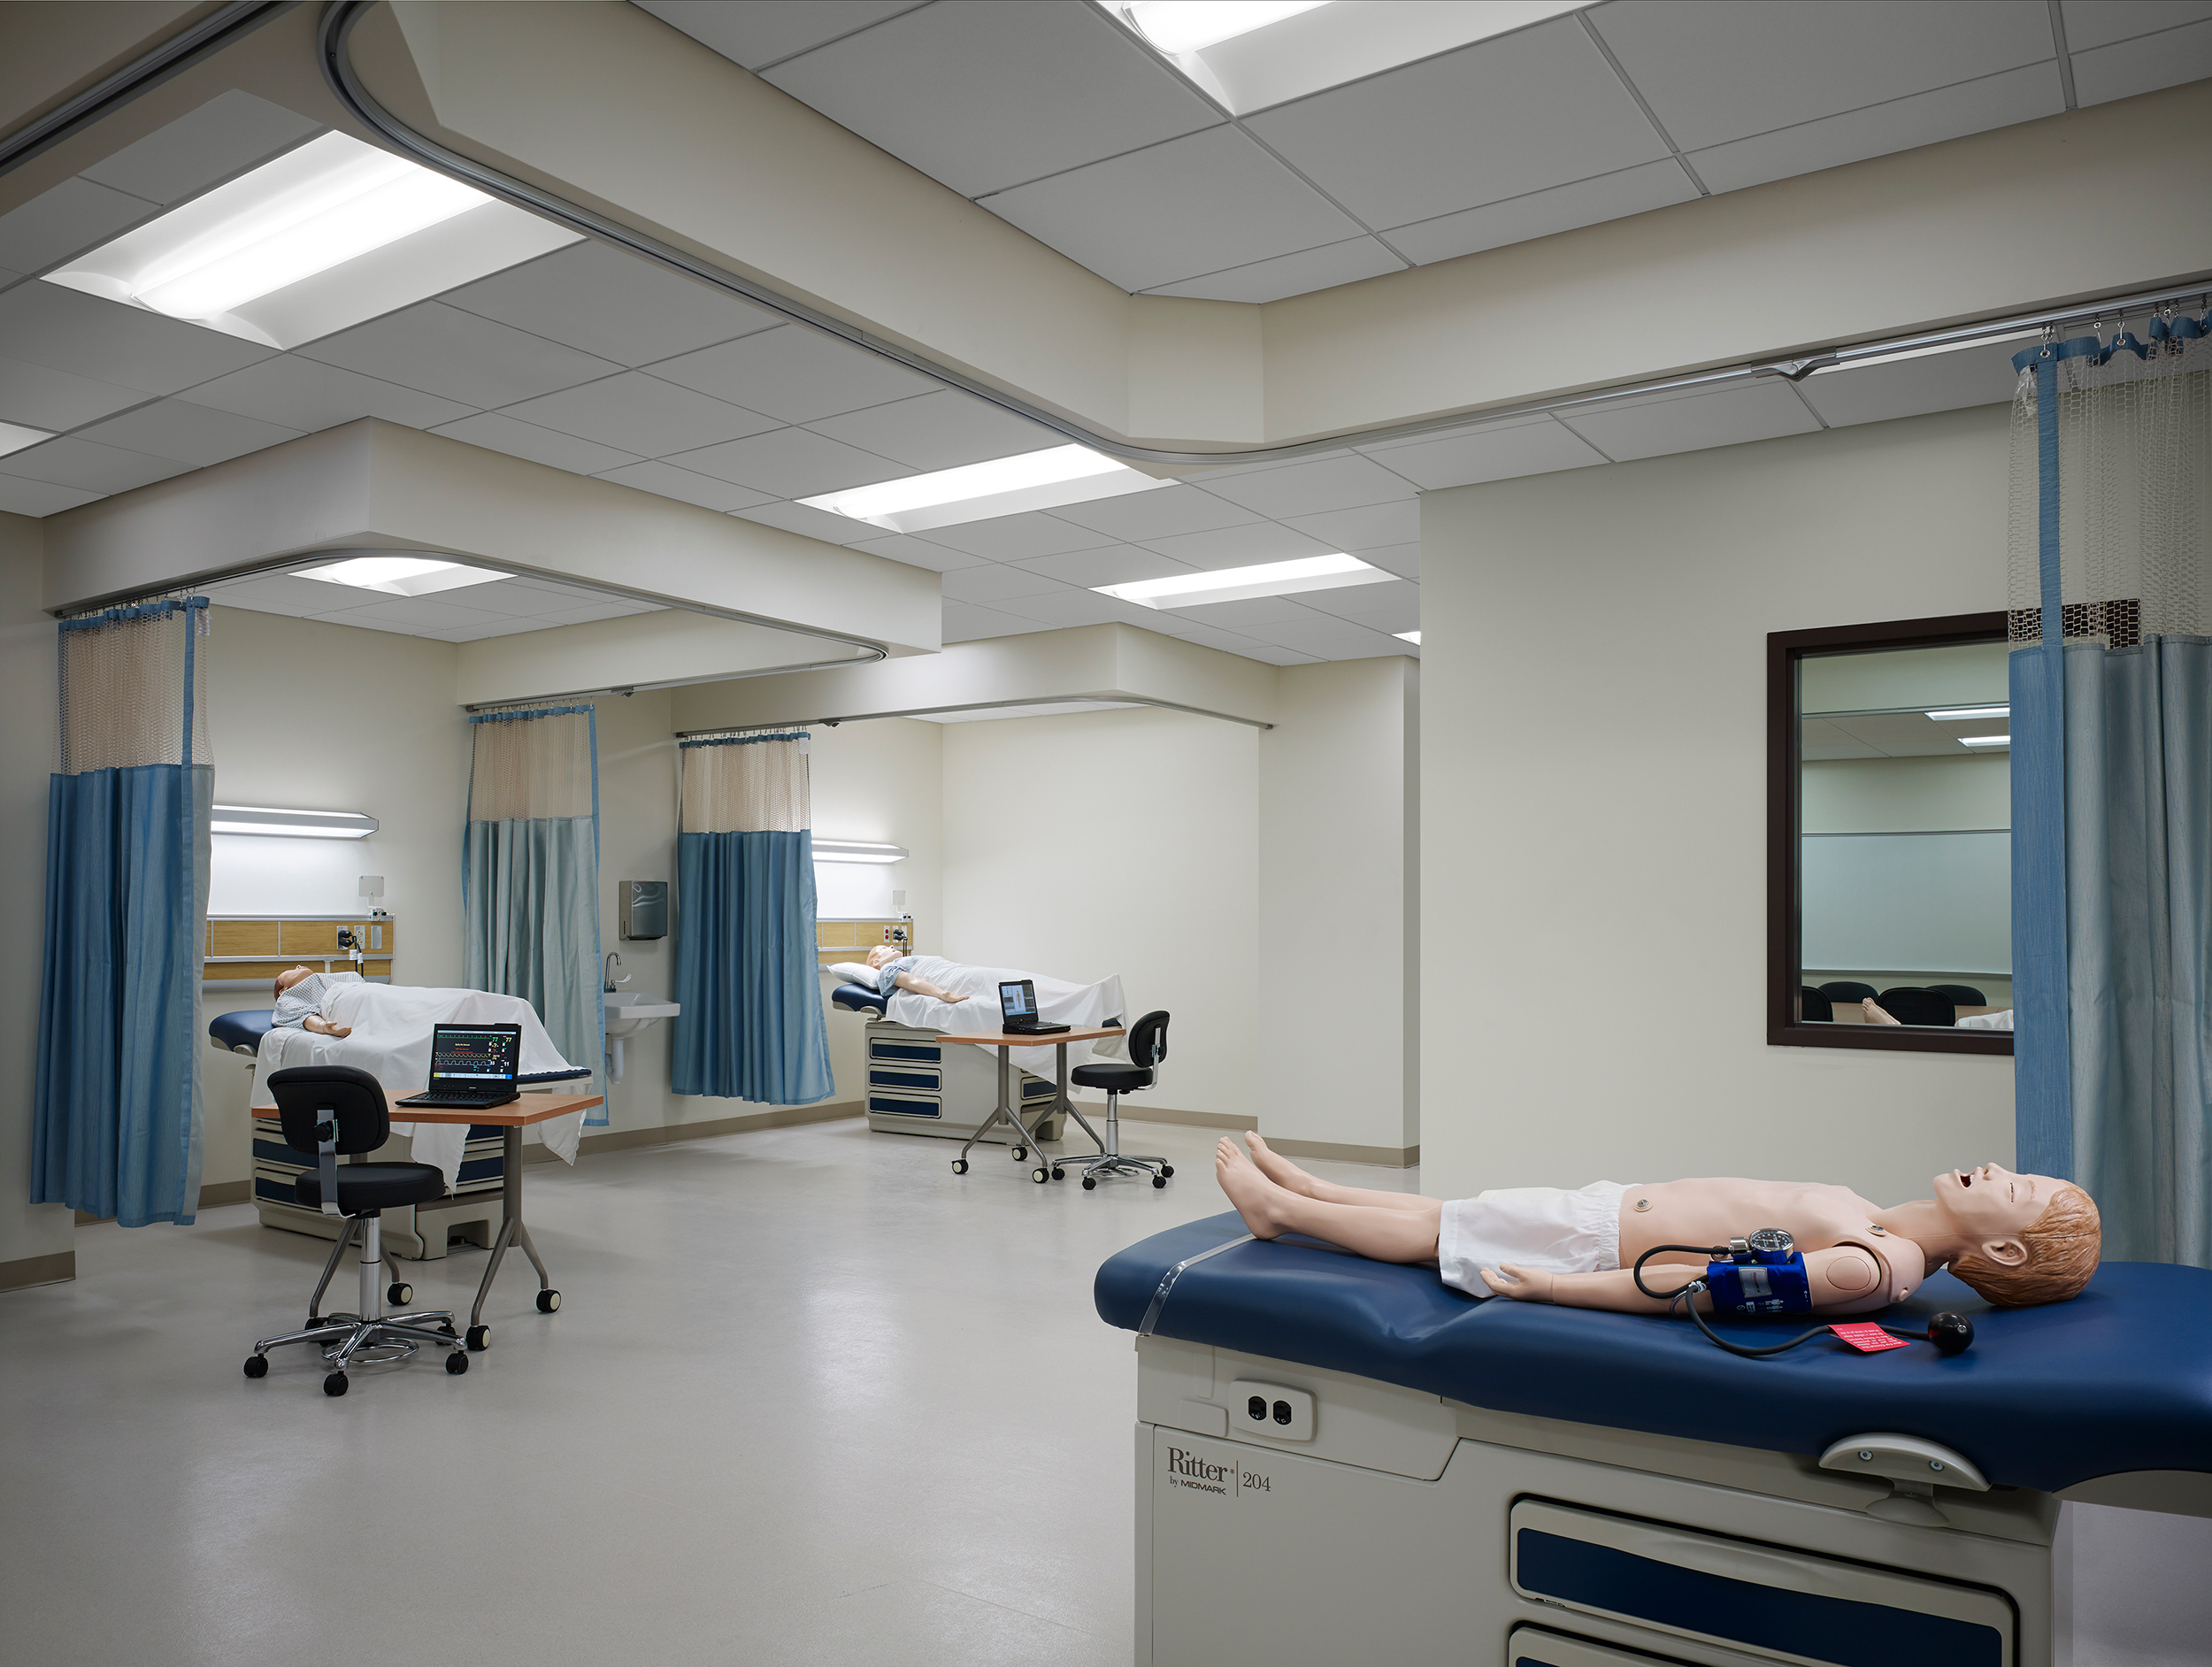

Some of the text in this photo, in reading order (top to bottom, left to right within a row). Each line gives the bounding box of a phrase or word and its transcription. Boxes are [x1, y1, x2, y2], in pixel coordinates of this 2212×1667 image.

[1167, 1447, 1271, 1492] Ritter 204
[1170, 1476, 1226, 1495] by MIDMARK
